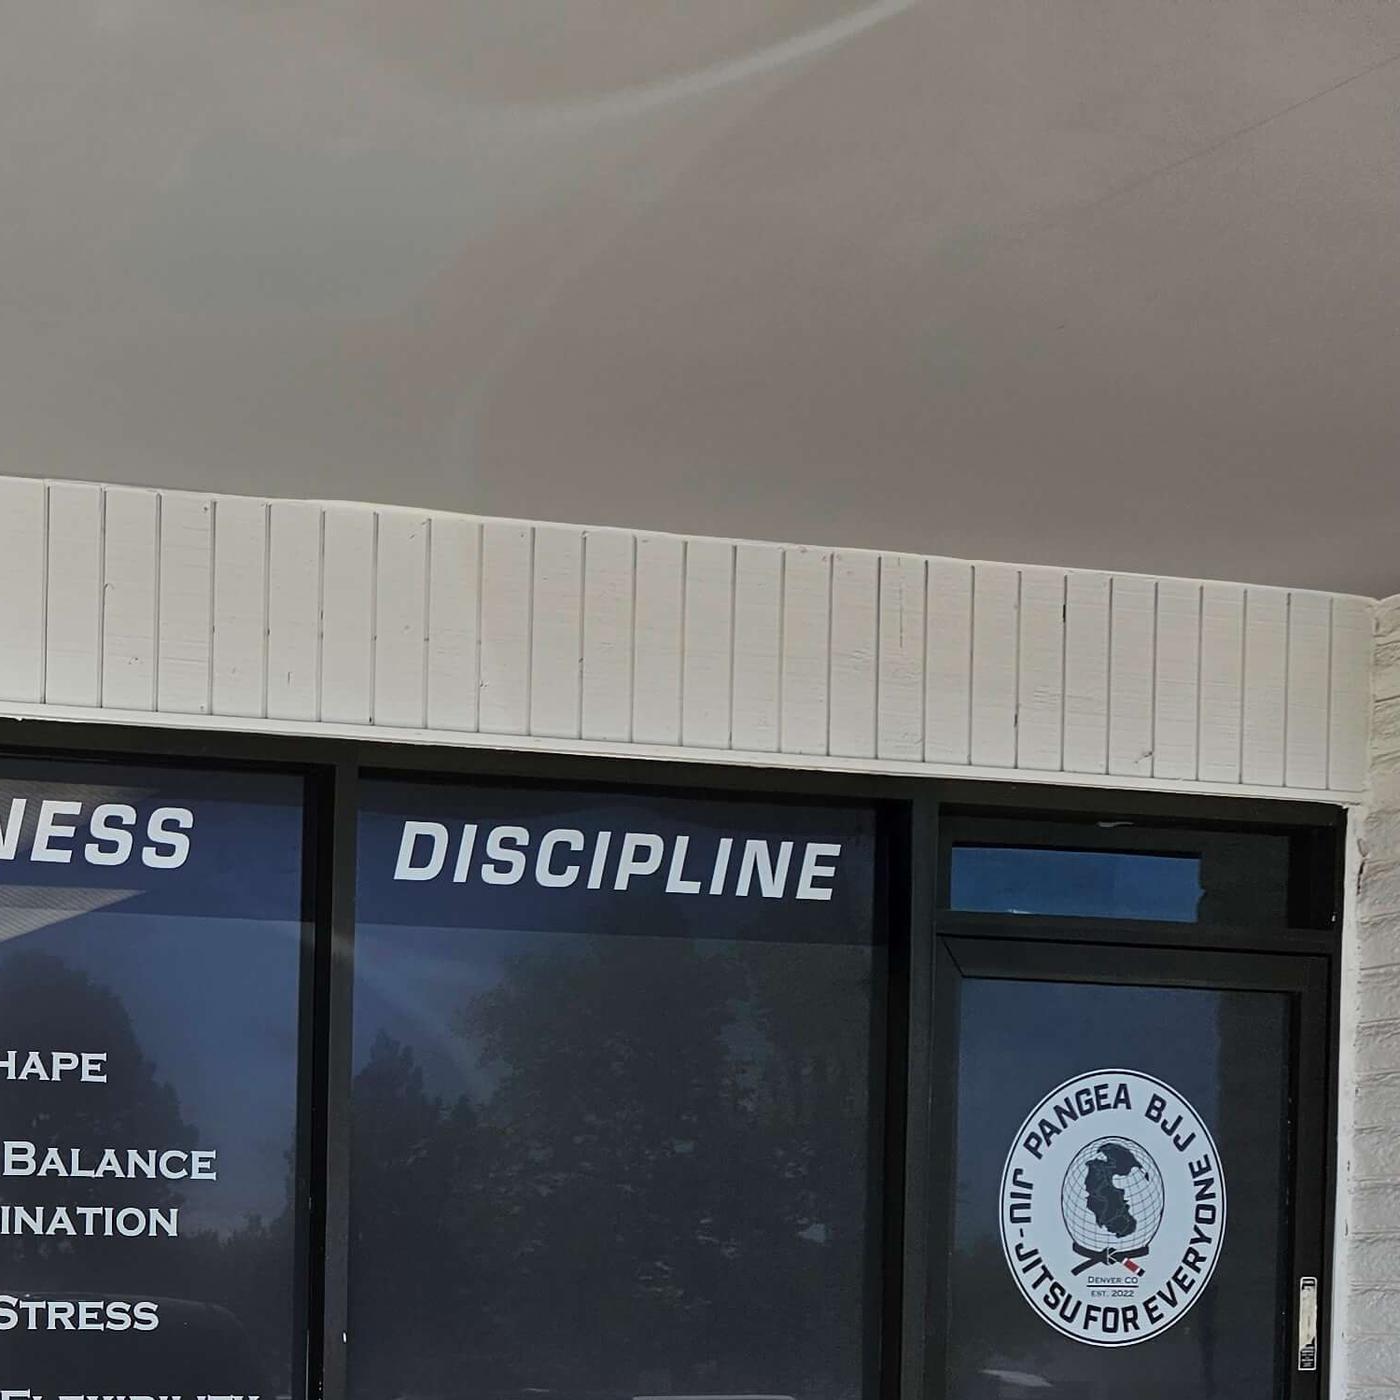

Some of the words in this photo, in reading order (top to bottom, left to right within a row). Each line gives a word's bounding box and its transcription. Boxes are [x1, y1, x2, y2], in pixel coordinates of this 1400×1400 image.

[394, 821, 841, 901] DISCIPLINE
[1023, 1083, 1132, 1159] PANGEA
[1145, 1093, 1196, 1152] BJJ
[3, 1141, 217, 1181] BALANCE
[1083, 1304, 1140, 1333] FOR
[1144, 1154, 1217, 1325] EVERYONE
